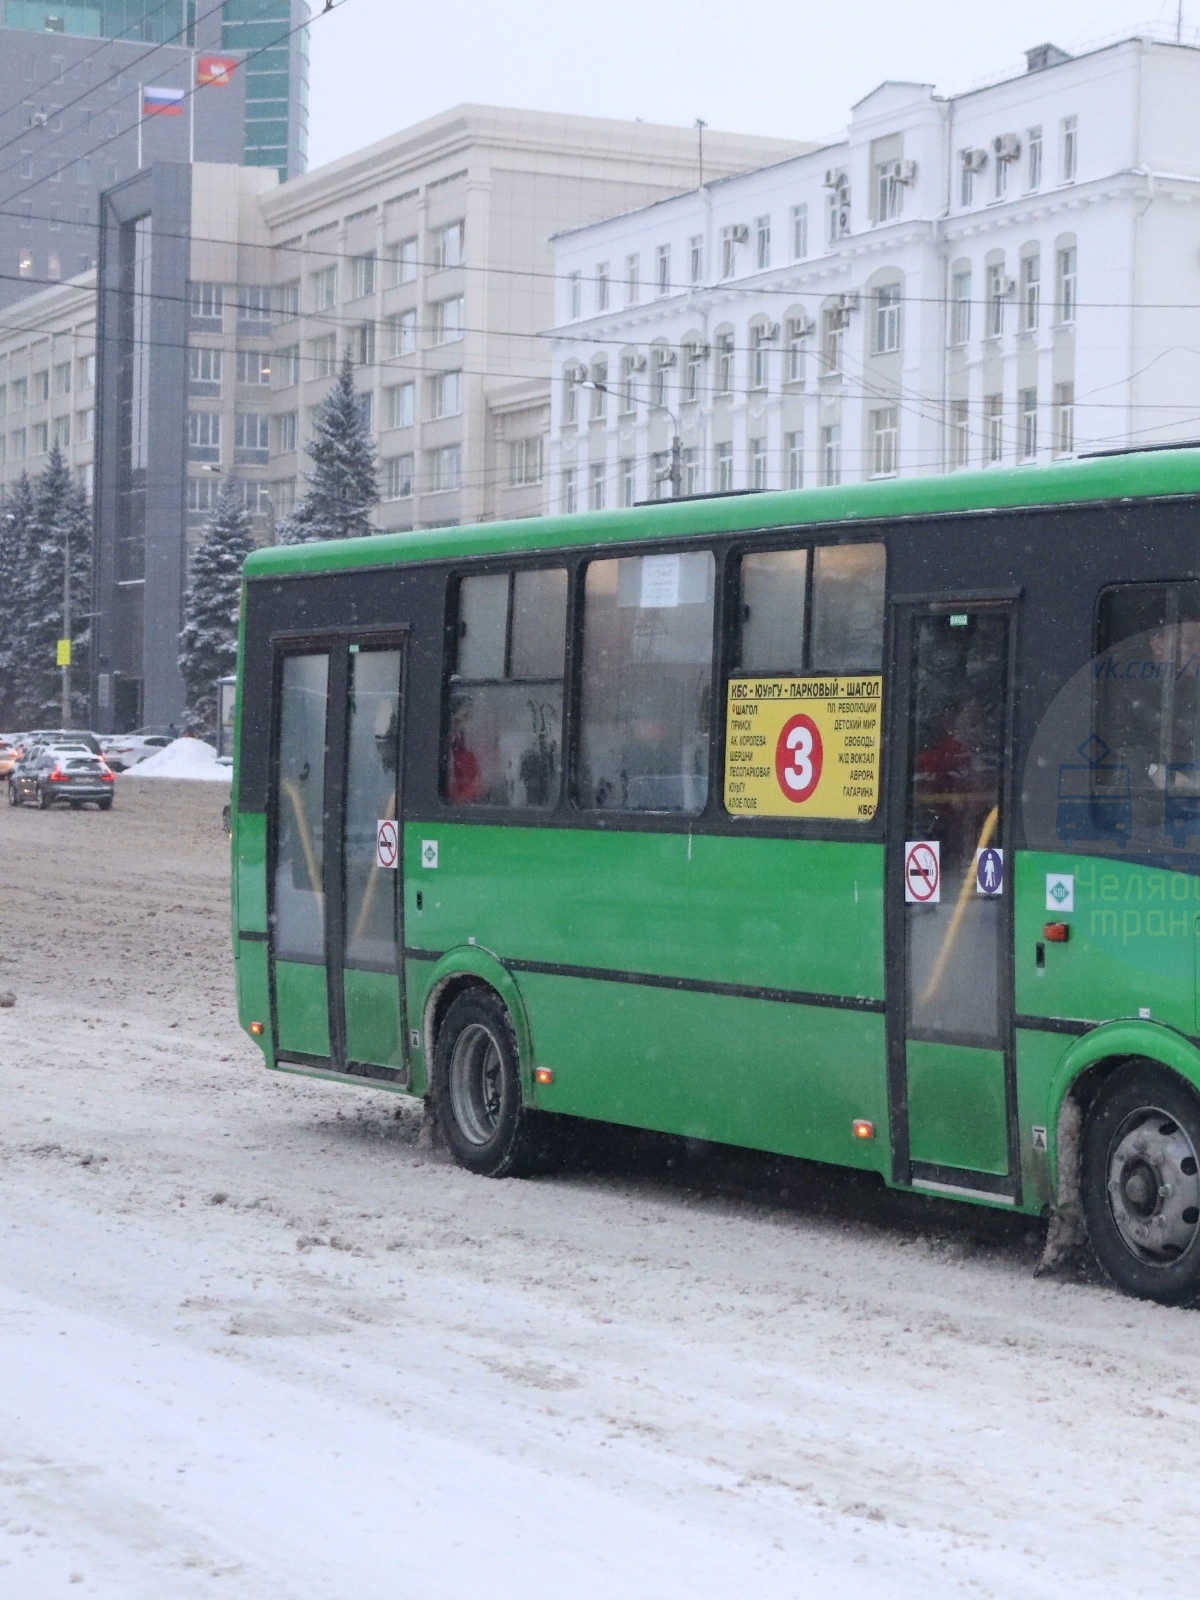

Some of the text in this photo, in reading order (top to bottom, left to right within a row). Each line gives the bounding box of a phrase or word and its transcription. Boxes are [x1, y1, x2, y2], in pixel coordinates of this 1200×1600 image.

[732, 684, 748, 698] КБС
[755, 684, 782, 698] ЮУрГУ
[790, 678, 839, 697] ПАРКОВЫЙ
[847, 682, 879, 697] ШАГОЛ
[736, 705, 758, 715] ШАГОЛ
[838, 702, 877, 715] РЕВОЛЮЦИИ
[834, 718, 877, 731] ДЕТСКИЙ МИР
[739, 735, 766, 746] КОРОЛЕВА
[844, 736, 875, 748] СВОБОДЫ
[785, 726, 813, 790] 3
[850, 753, 875, 764] ВОКЗАЛ
[729, 767, 770, 778] ЛЕСОПАРКОВАЯ
[850, 770, 874, 780] АВРОРА
[843, 786, 873, 798] ГАГАРИНА
[858, 805, 872, 815] КБС
